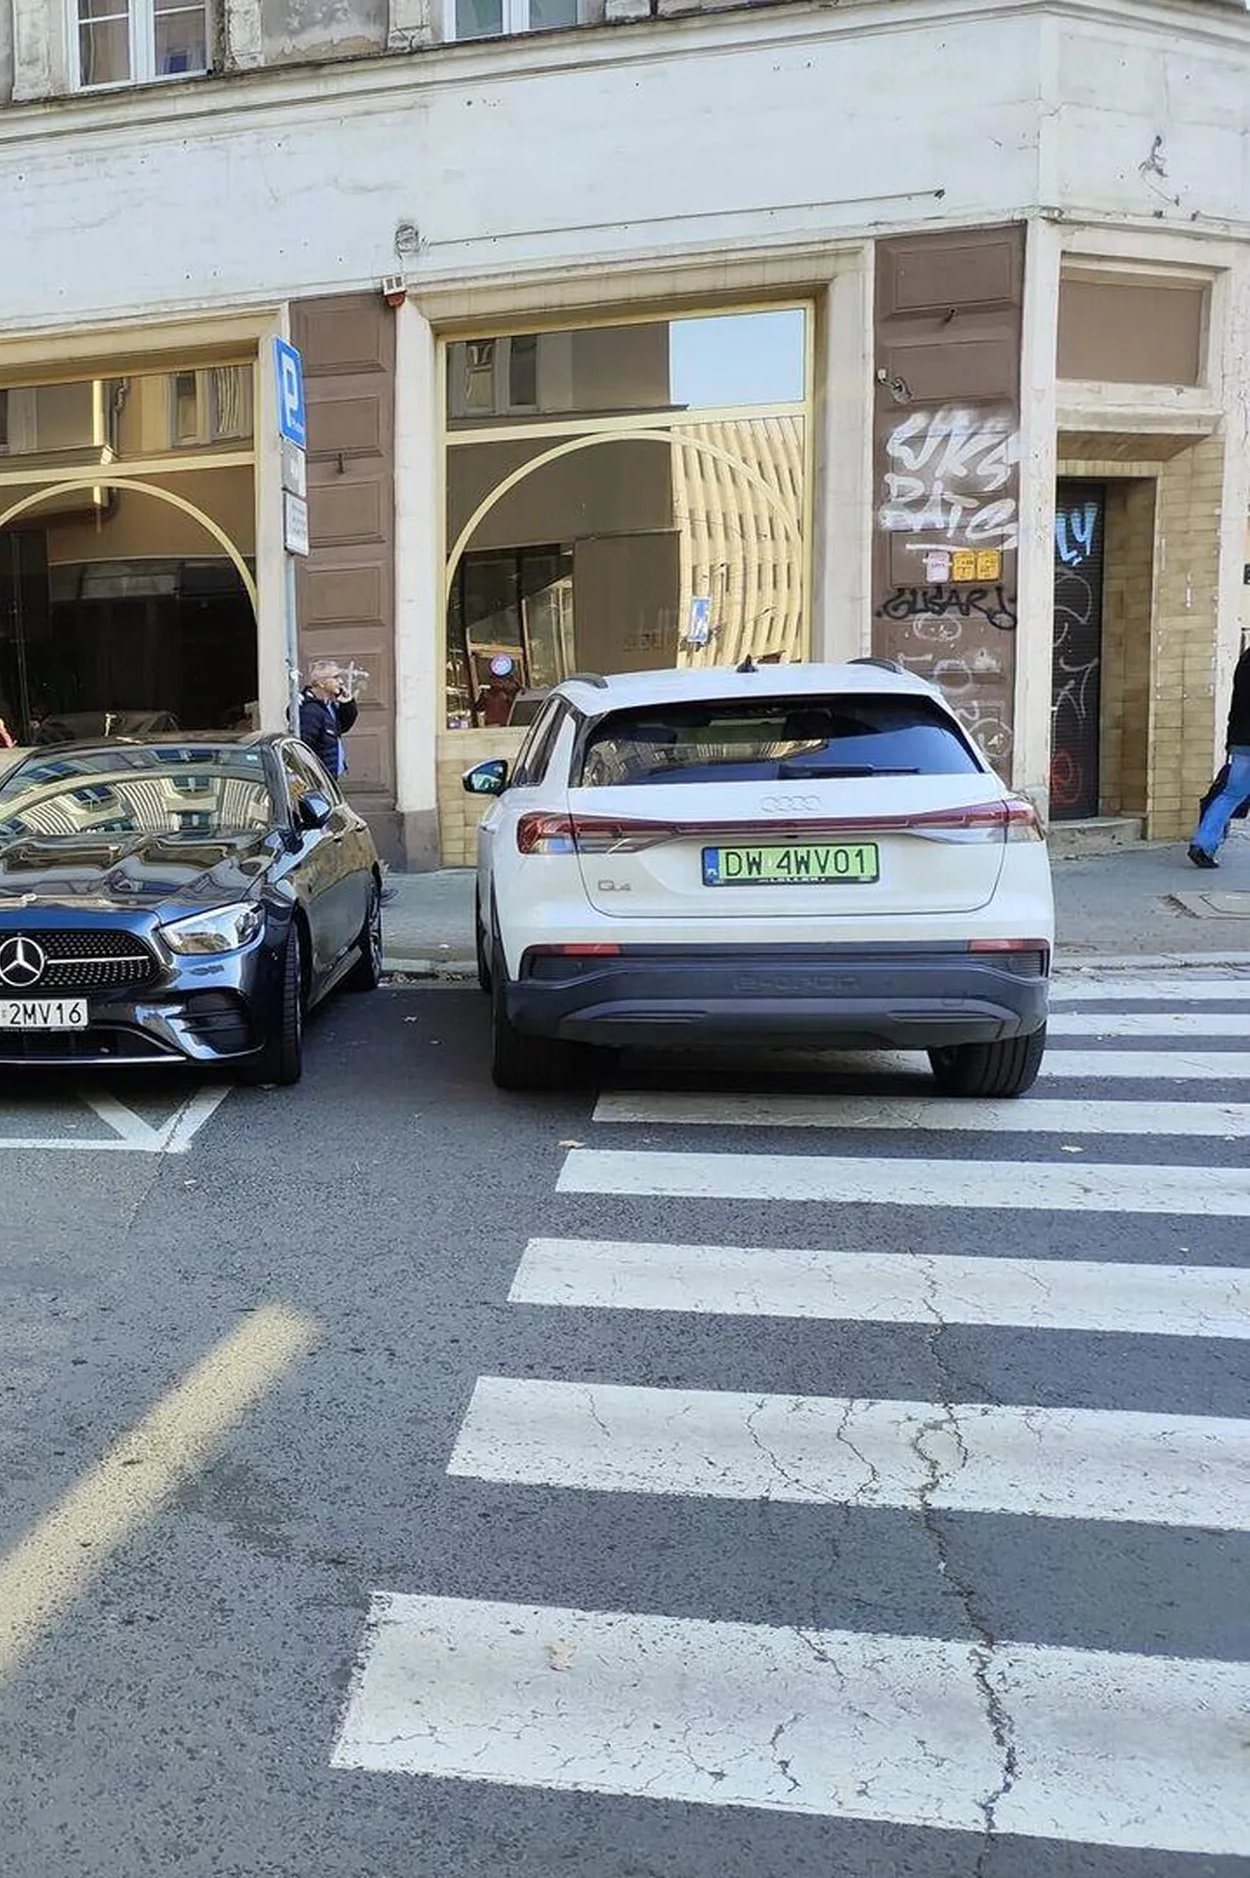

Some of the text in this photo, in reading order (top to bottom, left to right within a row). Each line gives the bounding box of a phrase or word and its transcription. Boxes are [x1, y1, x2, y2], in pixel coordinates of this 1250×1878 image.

[281, 351, 299, 428] P
[725, 849, 864, 876] DW 4WV01
[9, 1002, 82, 1024] 2MV16
